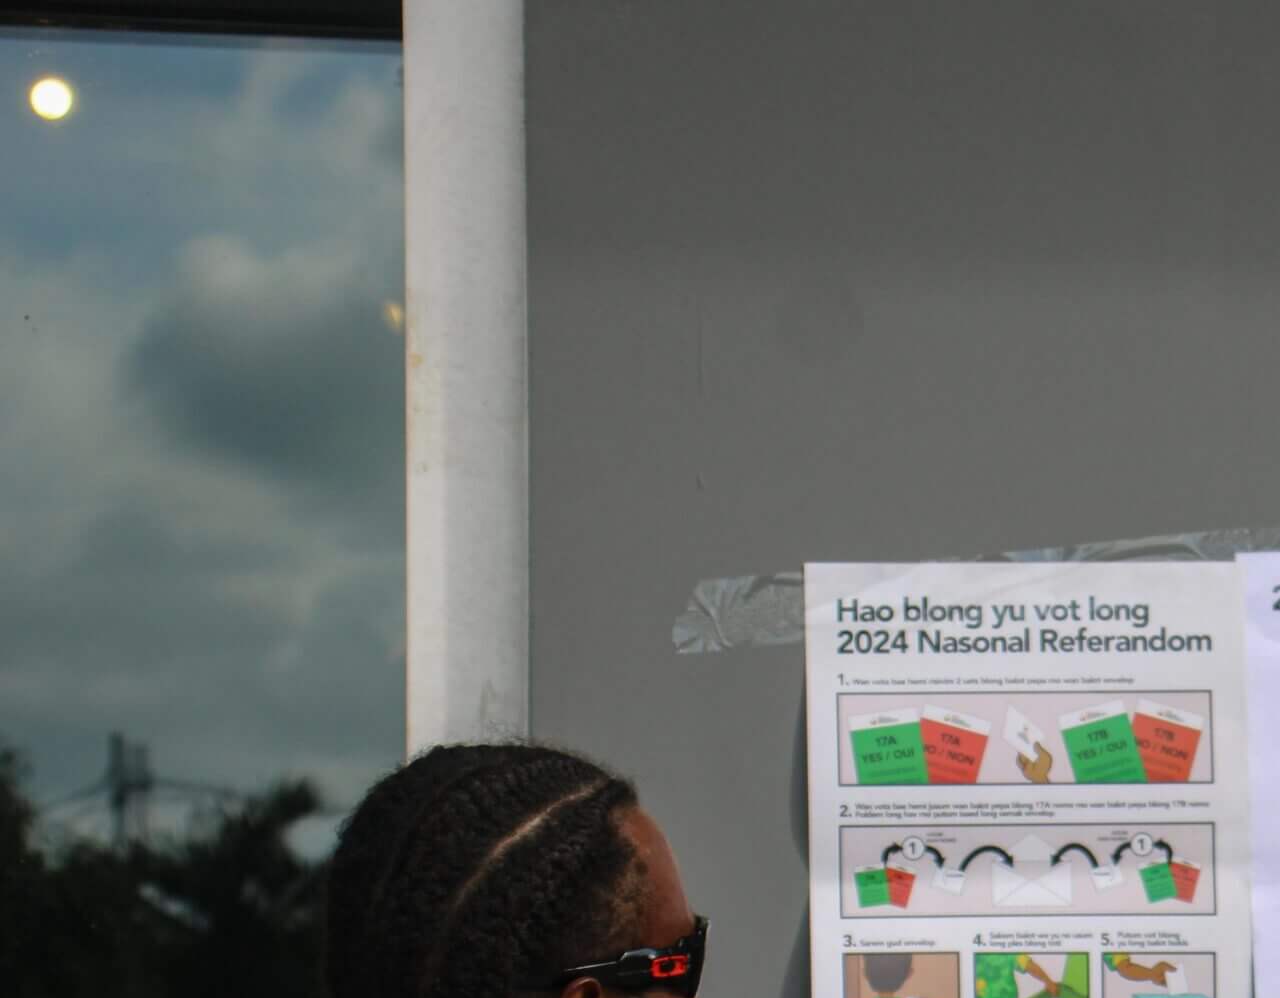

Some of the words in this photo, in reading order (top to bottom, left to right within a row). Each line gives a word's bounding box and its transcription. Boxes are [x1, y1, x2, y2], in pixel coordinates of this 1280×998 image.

[837, 599, 894, 622] Hao
[904, 596, 982, 629] blong
[992, 604, 1025, 629] yu
[1034, 600, 1081, 621] vot
[1090, 596, 1150, 628] long
[837, 630, 908, 654] 2024
[918, 628, 1030, 654] Nasonal
[1040, 626, 1212, 652] Referandom
[837, 673, 848, 686] 1.
[840, 804, 852, 818] 2.
[909, 842, 916, 854] 1
[1138, 838, 1144, 850] 1
[843, 934, 856, 948] 3.
[973, 933, 986, 946] 4.
[1102, 934, 1114, 946] 5.
